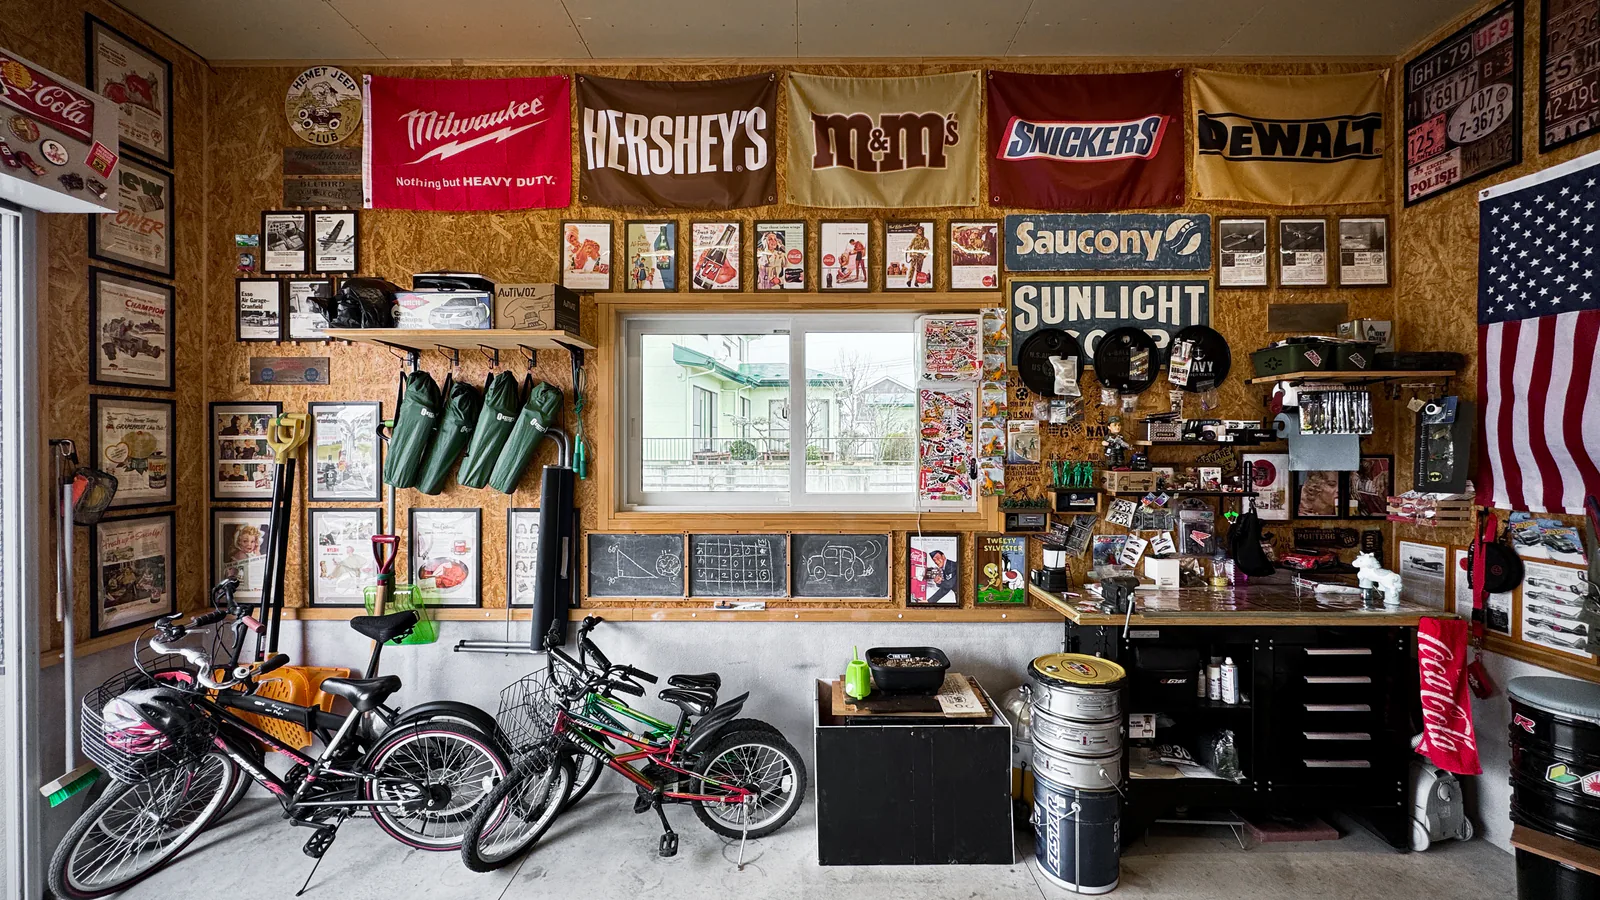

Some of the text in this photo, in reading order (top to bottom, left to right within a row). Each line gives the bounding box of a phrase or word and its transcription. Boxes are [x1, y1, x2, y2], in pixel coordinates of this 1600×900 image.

[292, 67, 356, 92] HEMET JEEP
[307, 131, 339, 144] CLUB
[398, 97, 545, 150] Milwaukee
[583, 106, 768, 176] HERSHEY'S
[1004, 116, 1160, 159] SNICKERS
[1199, 117, 1382, 158] DEWALT
[396, 175, 555, 190] Nothing but HEAVY DUTY.
[1410, 167, 1458, 197] POLISH
[102, 210, 164, 239] OWER
[1016, 221, 1163, 262] Saucony
[125, 299, 166, 315] CHAMPION
[1014, 284, 1205, 332] SUNLIGHT
[1191, 362, 1213, 373] AVY
[1046, 794, 1061, 877] ECSTAR
